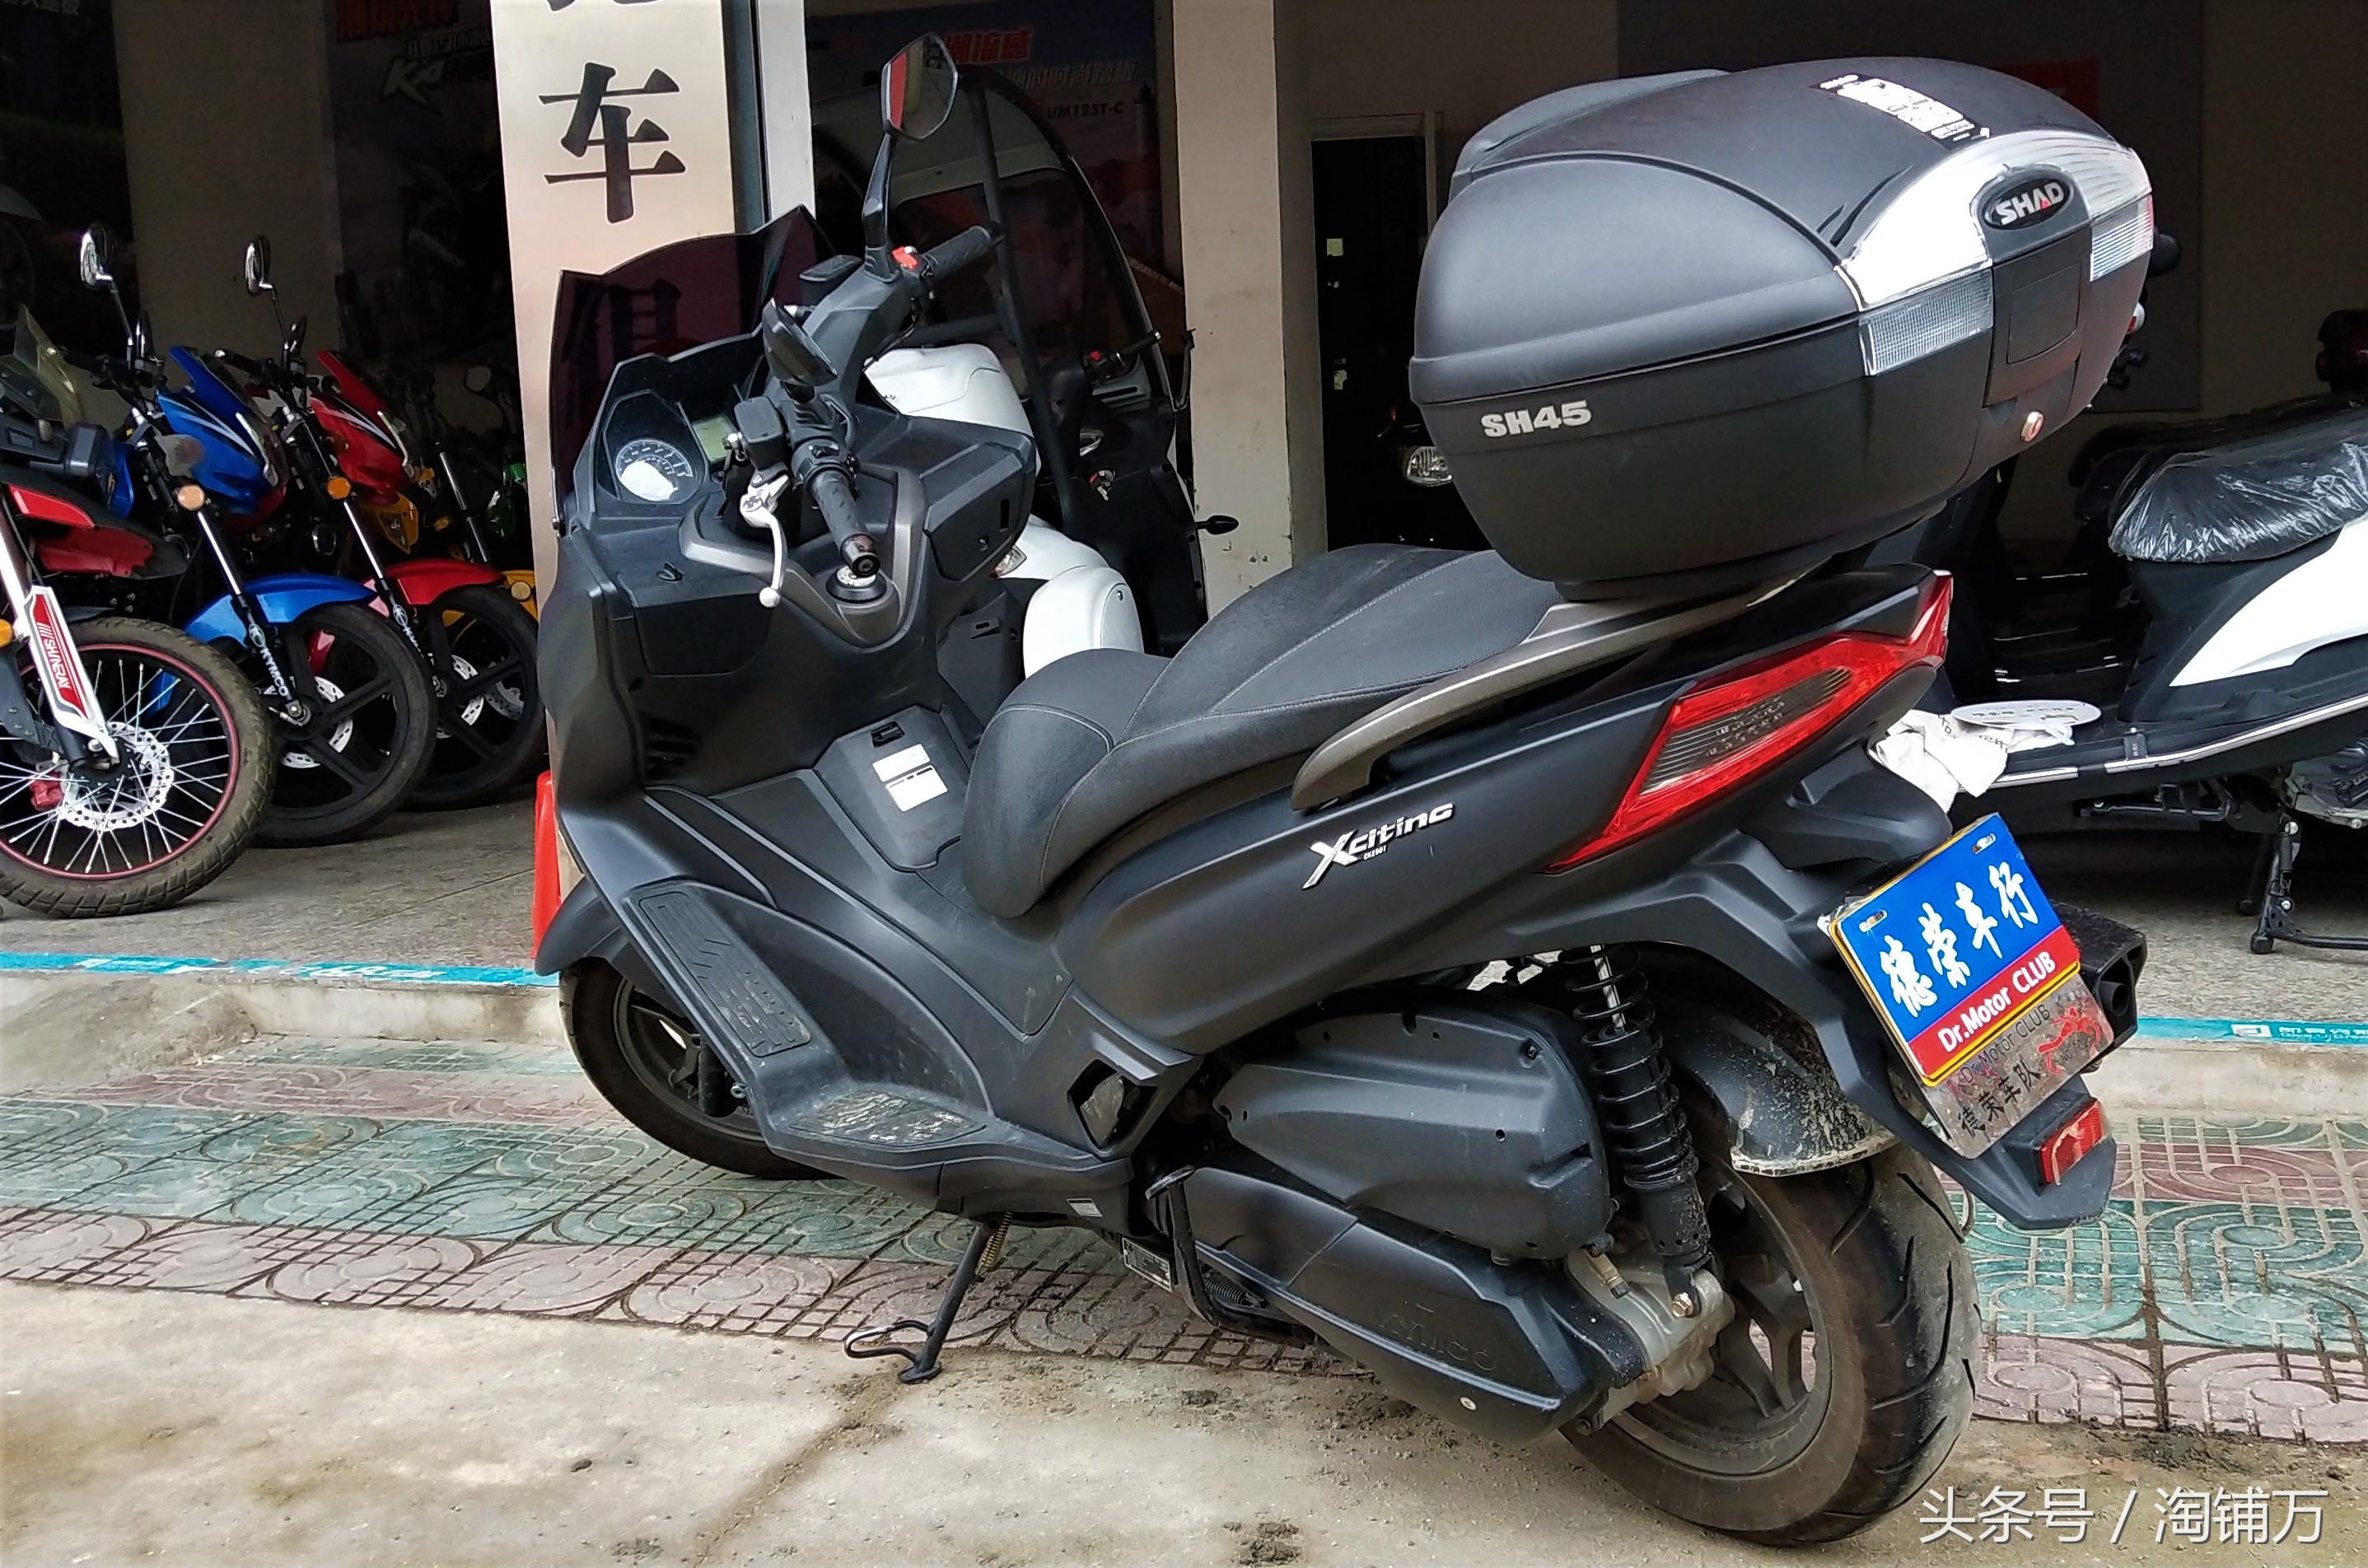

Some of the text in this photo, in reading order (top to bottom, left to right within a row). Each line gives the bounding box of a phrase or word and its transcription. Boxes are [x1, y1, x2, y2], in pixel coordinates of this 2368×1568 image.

[539, 0, 686, 223] 车
[1047, 101, 1124, 119] UM125T-C
[1995, 182, 2064, 226] SHAD
[1480, 399, 1592, 437] SH45
[43, 640, 72, 690] SHINERAY
[259, 647, 289, 697] KYMCO
[1937, 987, 2012, 1052] Dr.Motor
[2011, 951, 2057, 994] CLUB
[2015, 1004, 2052, 1039] CLUB
